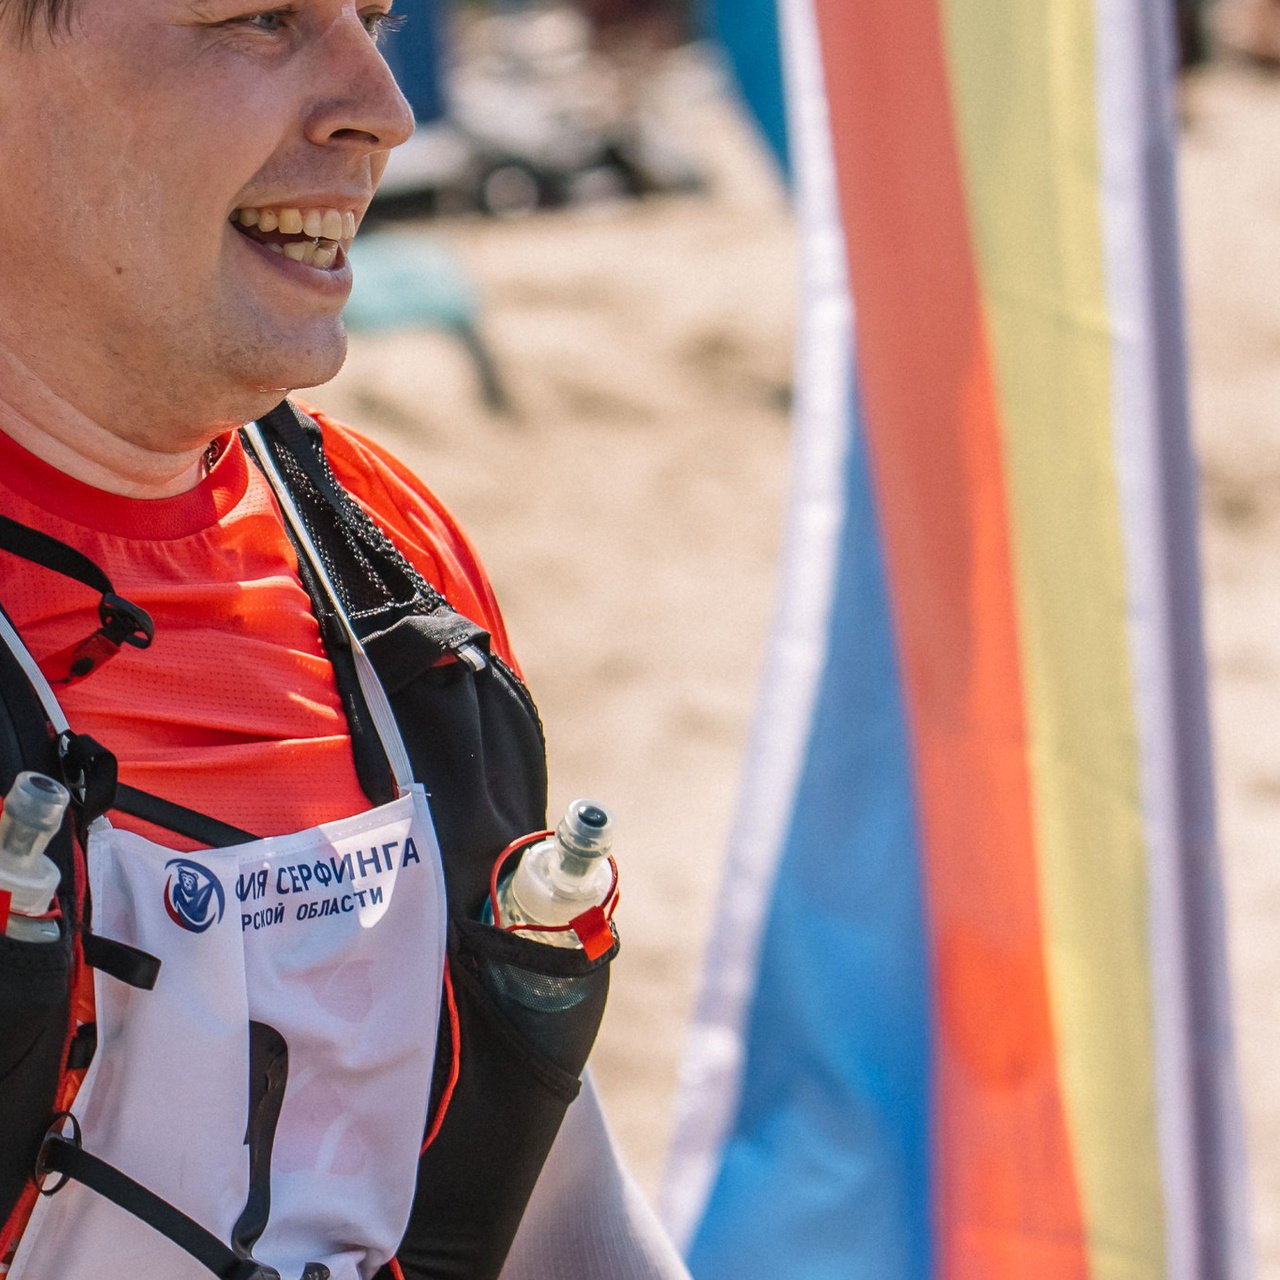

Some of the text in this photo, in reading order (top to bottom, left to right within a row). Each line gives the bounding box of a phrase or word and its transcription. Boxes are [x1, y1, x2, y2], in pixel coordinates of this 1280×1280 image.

[276, 837, 421, 896] СЕРФИНГА
[241, 886, 384, 932] РСКОЙ ОБЛАСТИ
